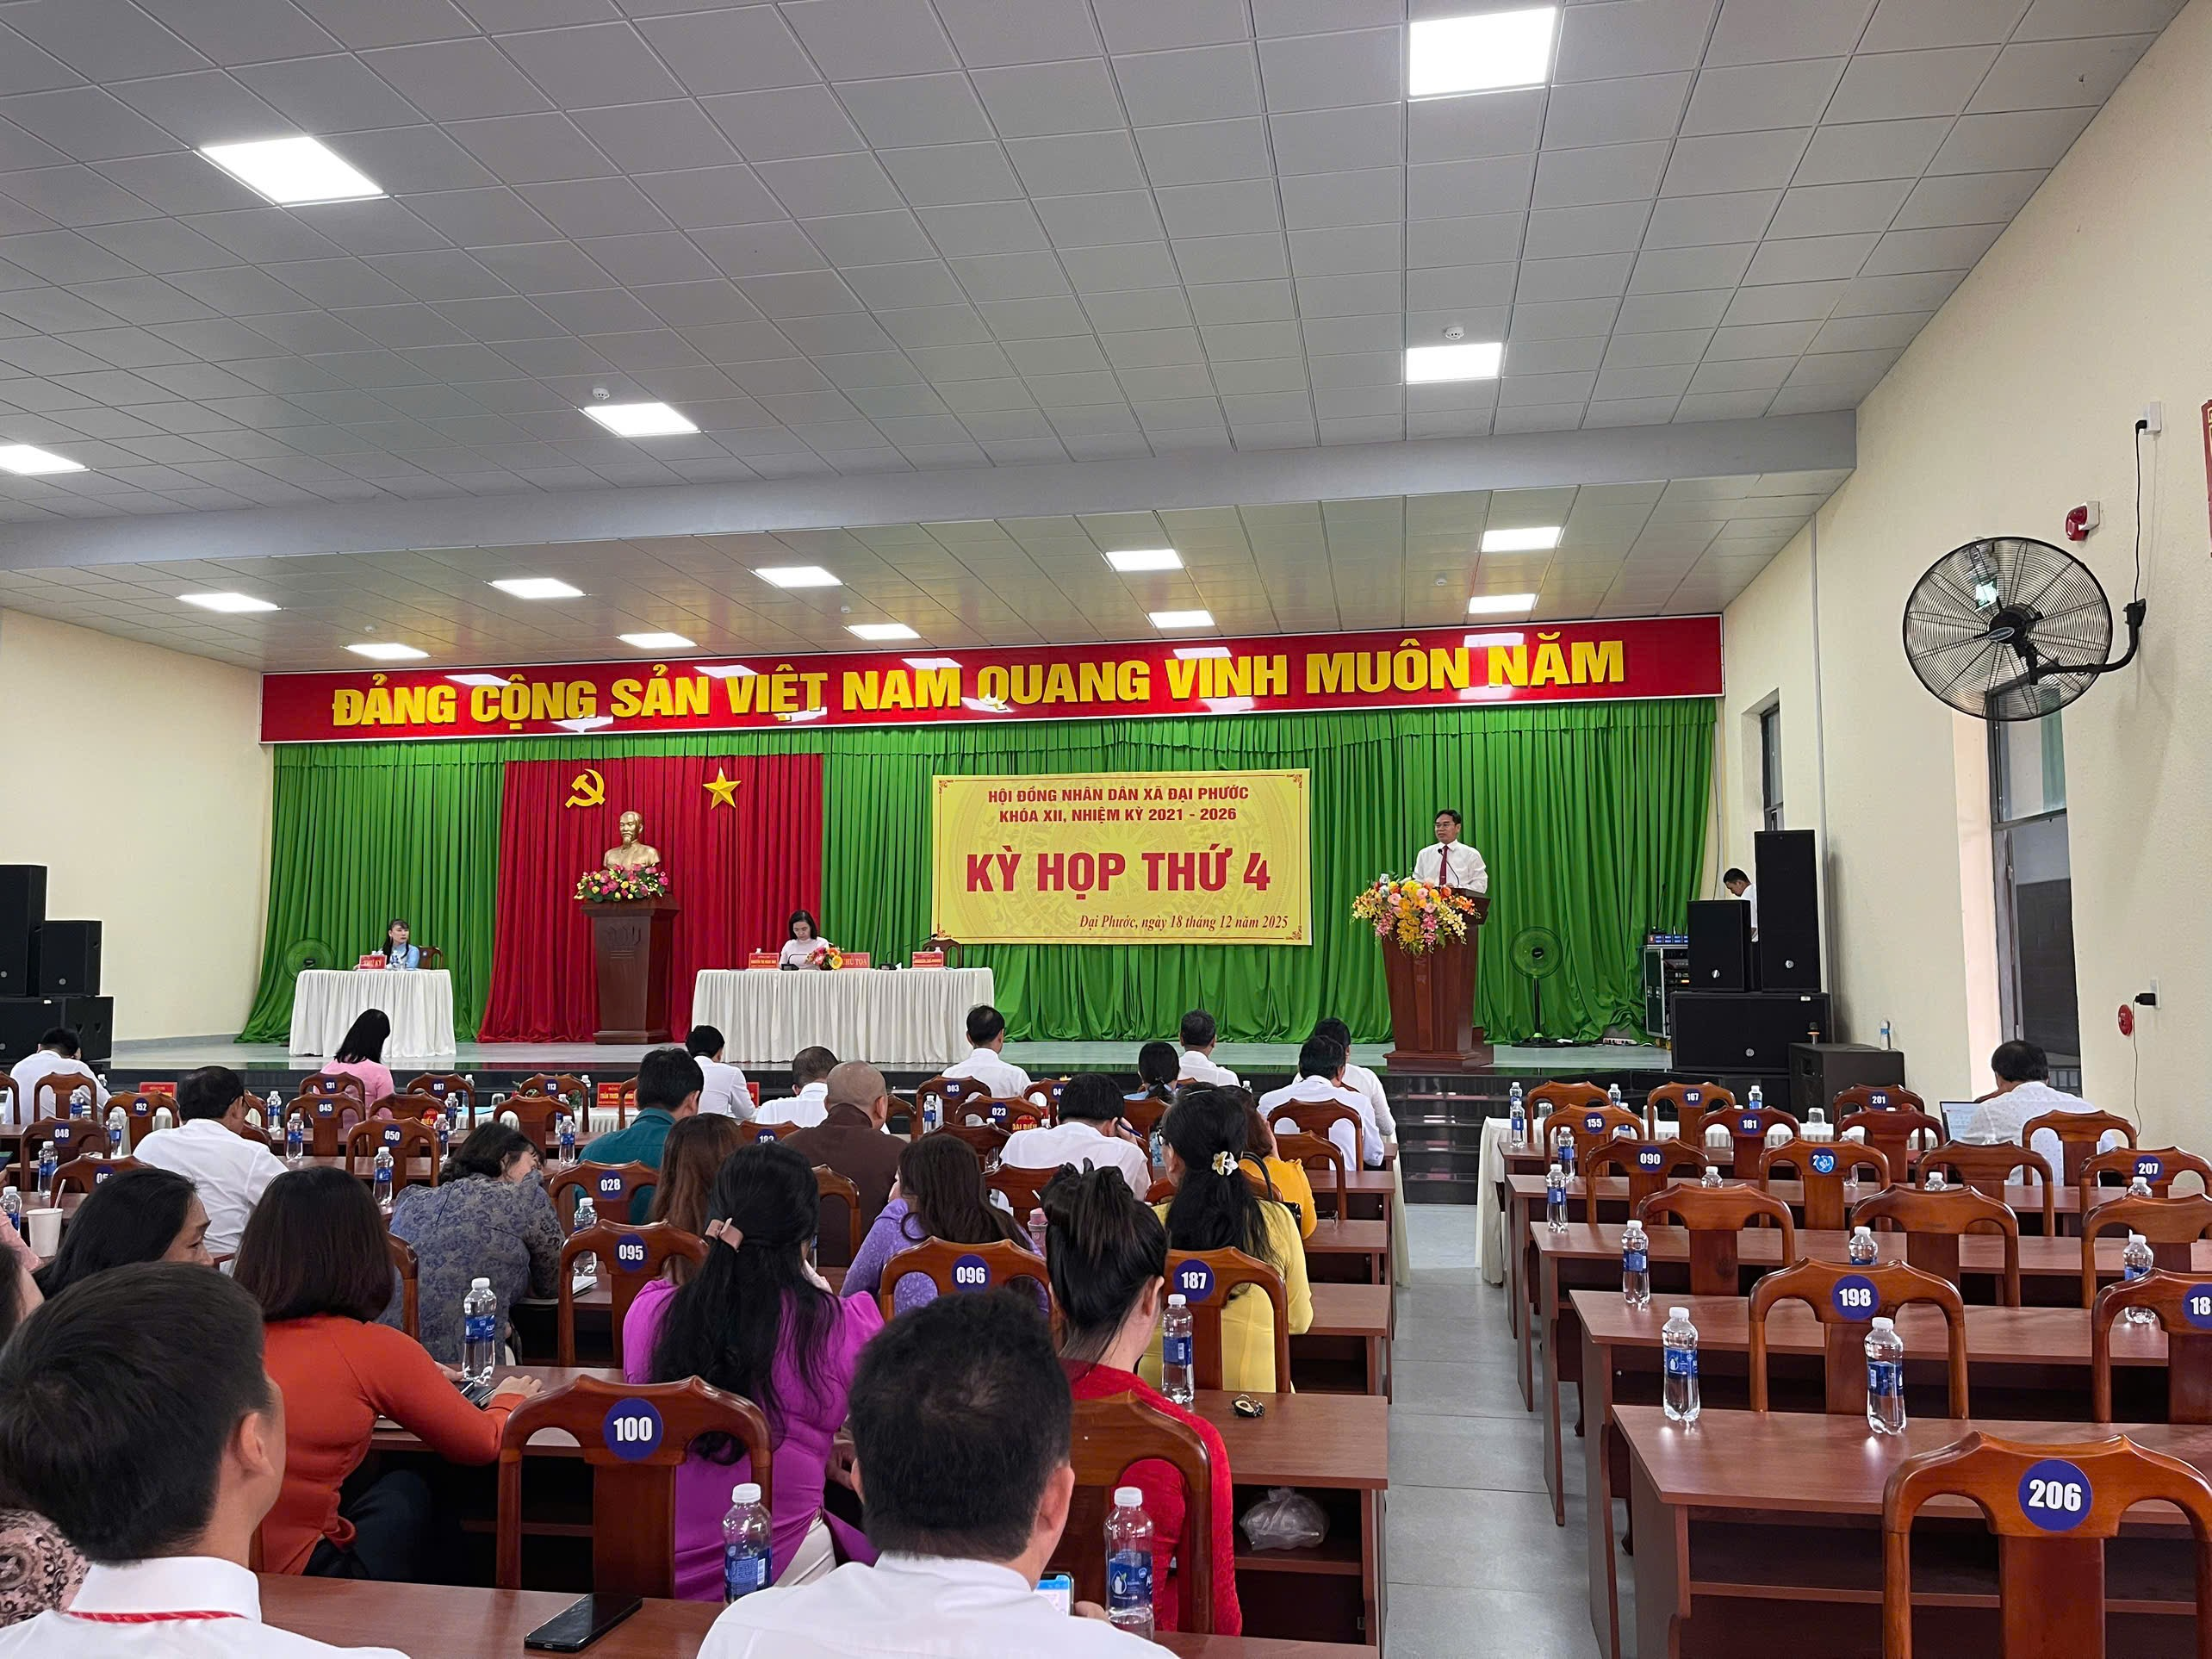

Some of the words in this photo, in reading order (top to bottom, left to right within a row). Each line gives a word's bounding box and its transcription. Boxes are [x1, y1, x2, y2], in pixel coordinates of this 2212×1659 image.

[332, 674, 459, 726] ĐẢNG
[470, 674, 598, 730] CỘNG
[610, 663, 711, 718] SẢN
[725, 663, 829, 722] VIỆT
[842, 667, 961, 711] NAM
[977, 660, 1151, 711] QUANG
[1165, 655, 1289, 699] VINH
[1306, 638, 1470, 694] MUÔN
[1488, 631, 1625, 687] NĂM
[988, 788, 1012, 805] HỘI
[1017, 786, 1057, 802] ĐỒNG
[1062, 786, 1103, 801] NHÂN
[1108, 786, 1139, 801] DÂN
[1144, 786, 1164, 801] XÃ
[1168, 787, 1194, 803] ĐẠI
[1198, 785, 1249, 799] PHƯỚC
[999, 808, 1039, 823] KHÓA
[1043, 810, 1067, 823] XII,
[1072, 806, 1120, 824] NHIỆM
[1125, 806, 1144, 821] KỲ
[1148, 808, 1183, 821] 2021
[1200, 808, 1237, 821] 2026
[966, 845, 1022, 892] KỲ
[1036, 852, 1126, 900] HỌP
[1141, 843, 1233, 892] THỨ
[1243, 852, 1271, 892] 4
[1079, 915, 1098, 931] Đại
[1101, 915, 1138, 929] Phước,
[1141, 915, 1167, 931] ngày
[1171, 916, 1183, 929] 18
[1185, 915, 1216, 930] tháng
[1220, 915, 1233, 929] 12
[1235, 917, 1259, 929] năm
[1262, 916, 1288, 929] 2025
[135, 1102, 147, 1111] 152
[319, 1103, 332, 1113] 045
[1872, 1095, 1886, 1105] 201
[991, 1107, 1006, 1117] 023
[1586, 1118, 1603, 1129] 155
[1743, 1119, 1758, 1130] 181
[55, 1128, 70, 1139] 048
[384, 1129, 400, 1141] 050
[1639, 1153, 1661, 1165] 090
[2138, 1162, 2159, 1175] 207
[600, 1178, 621, 1192] 028
[618, 1244, 643, 1261] 095
[956, 1266, 986, 1284] 096
[1181, 1271, 1207, 1289] 187
[1838, 1288, 1872, 1307] 198
[2190, 1296, 2212, 1317] 18
[612, 1416, 653, 1442] 100
[2029, 1479, 2082, 1512] 206
